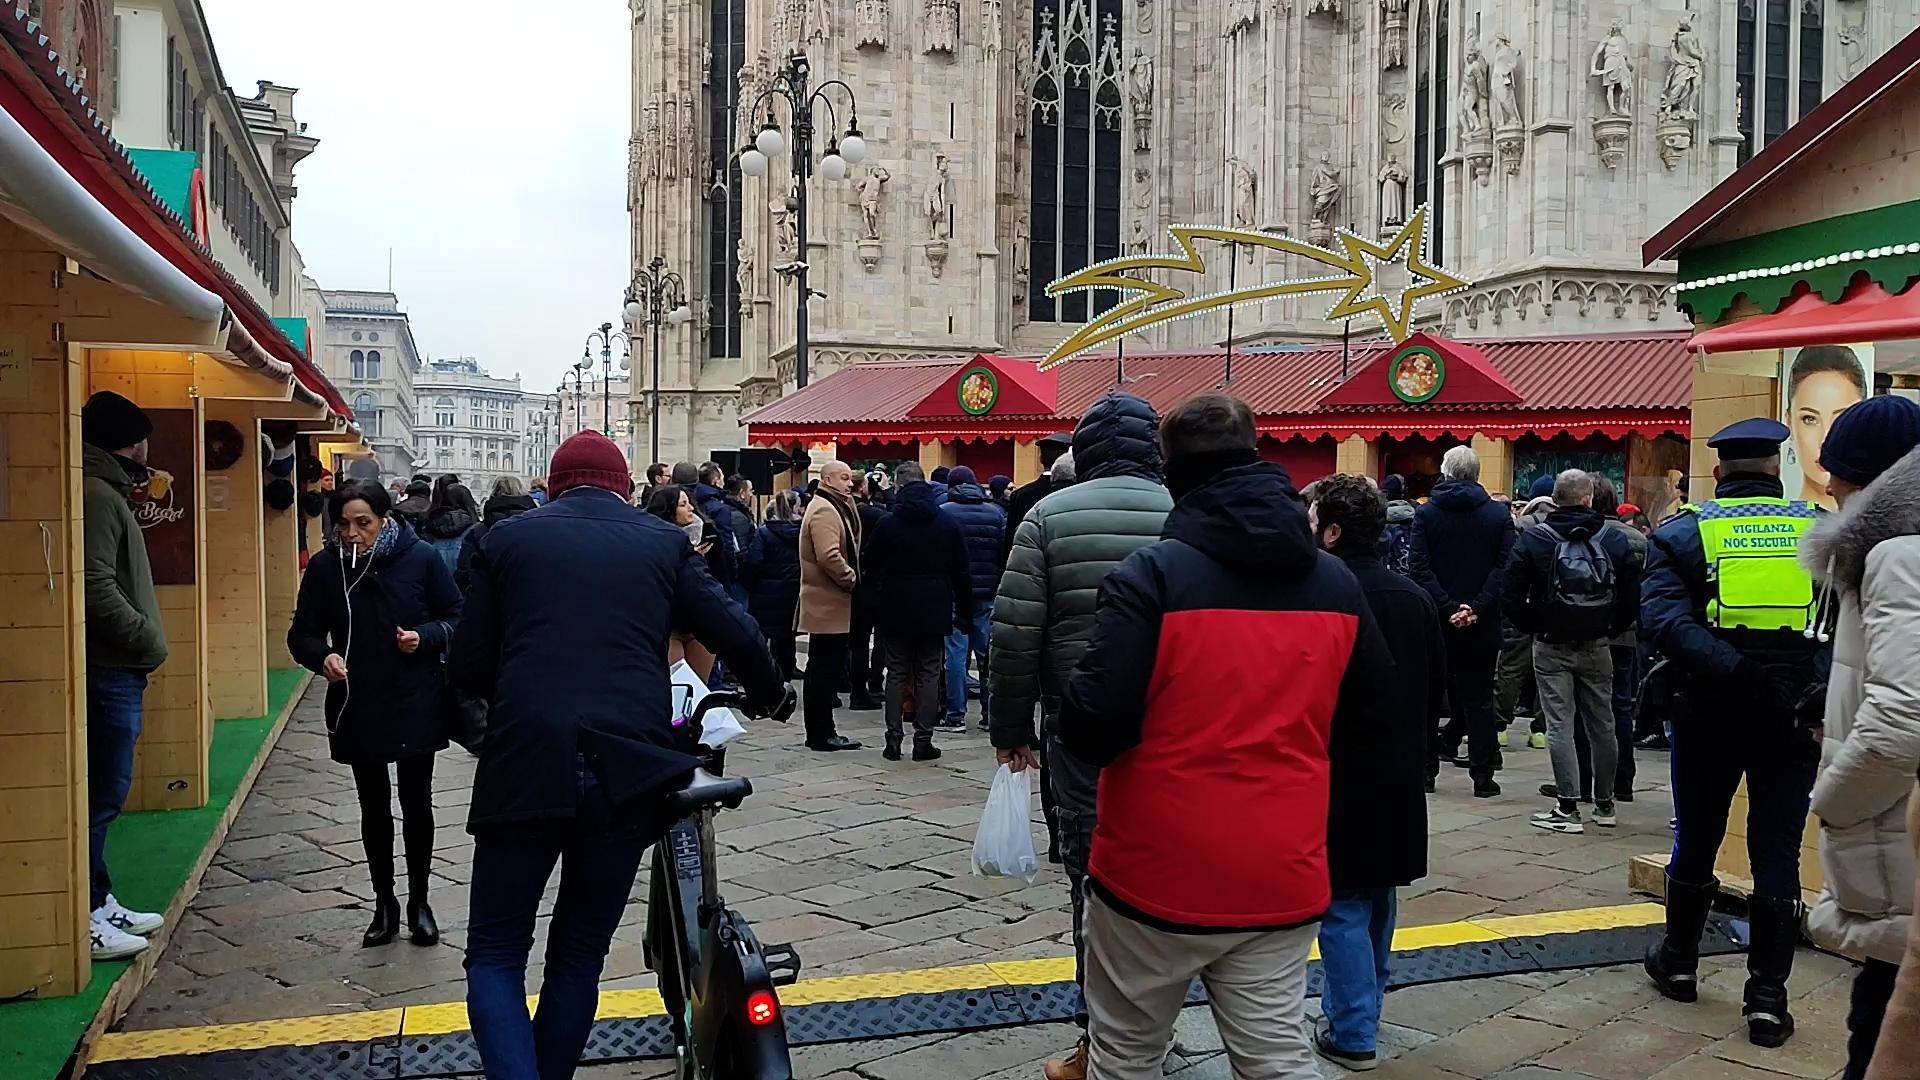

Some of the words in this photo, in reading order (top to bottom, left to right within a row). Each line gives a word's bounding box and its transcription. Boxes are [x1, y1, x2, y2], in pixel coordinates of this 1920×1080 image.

[1733, 524, 1795, 533] VIGILANZA
[1723, 538, 1748, 548] NOC
[1750, 537, 1799, 547] SECURIT
